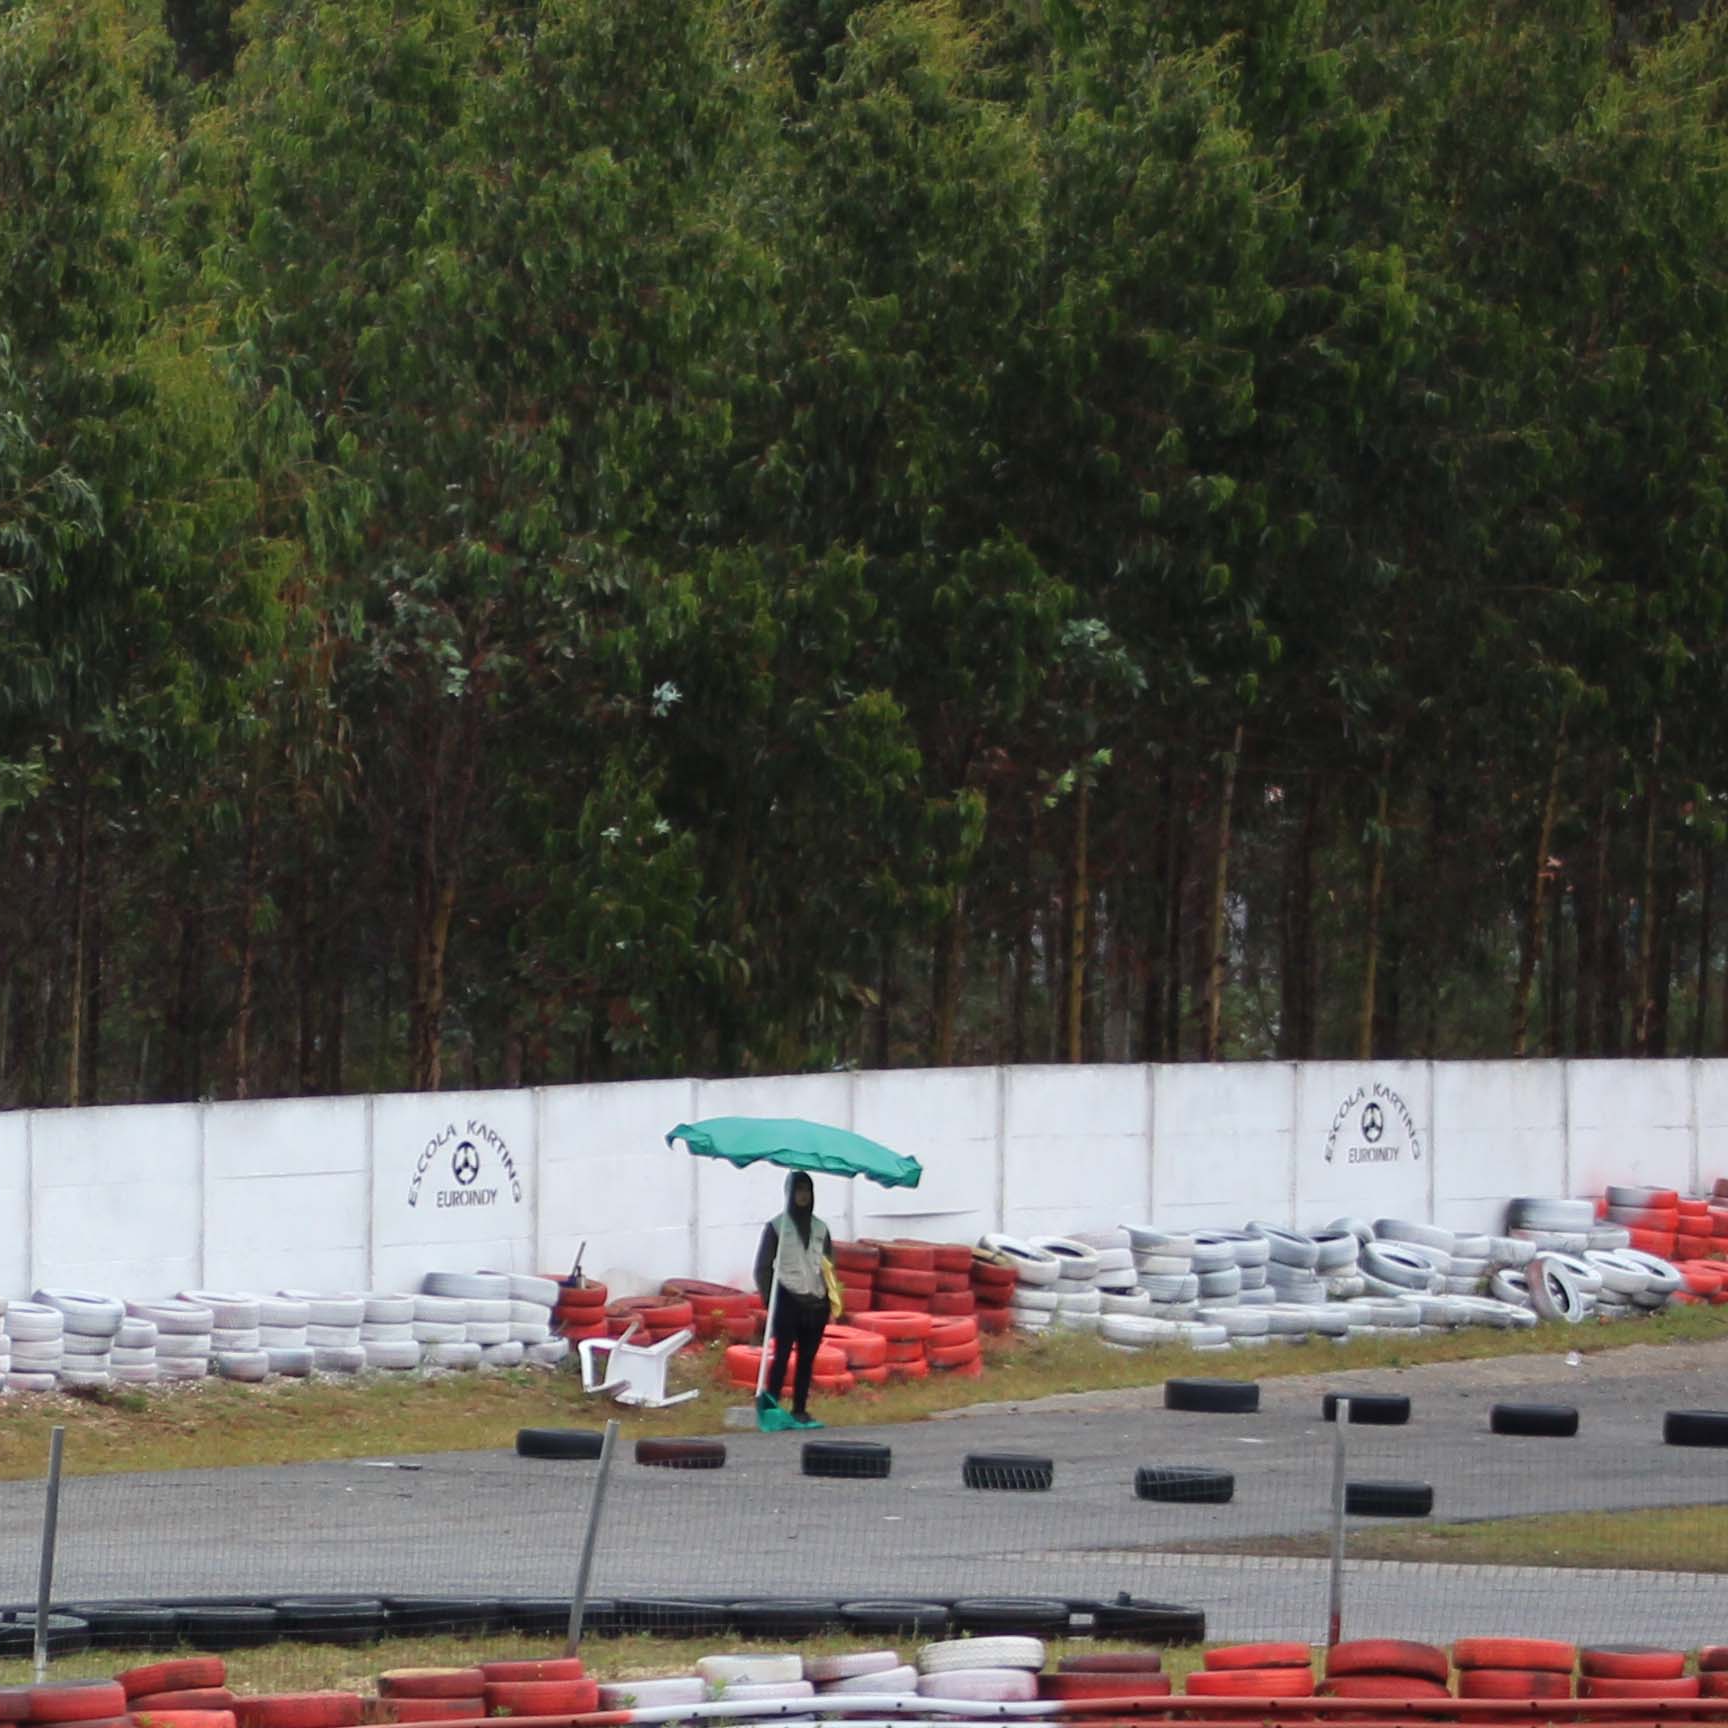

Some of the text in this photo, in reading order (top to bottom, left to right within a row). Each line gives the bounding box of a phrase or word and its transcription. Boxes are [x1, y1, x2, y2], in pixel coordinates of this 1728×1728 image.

[1325, 1083, 1421, 1163] ESCOLA KARTING
[408, 1120, 522, 1207] ESCOLA KARTING
[437, 1188, 498, 1208] EUROINDY
